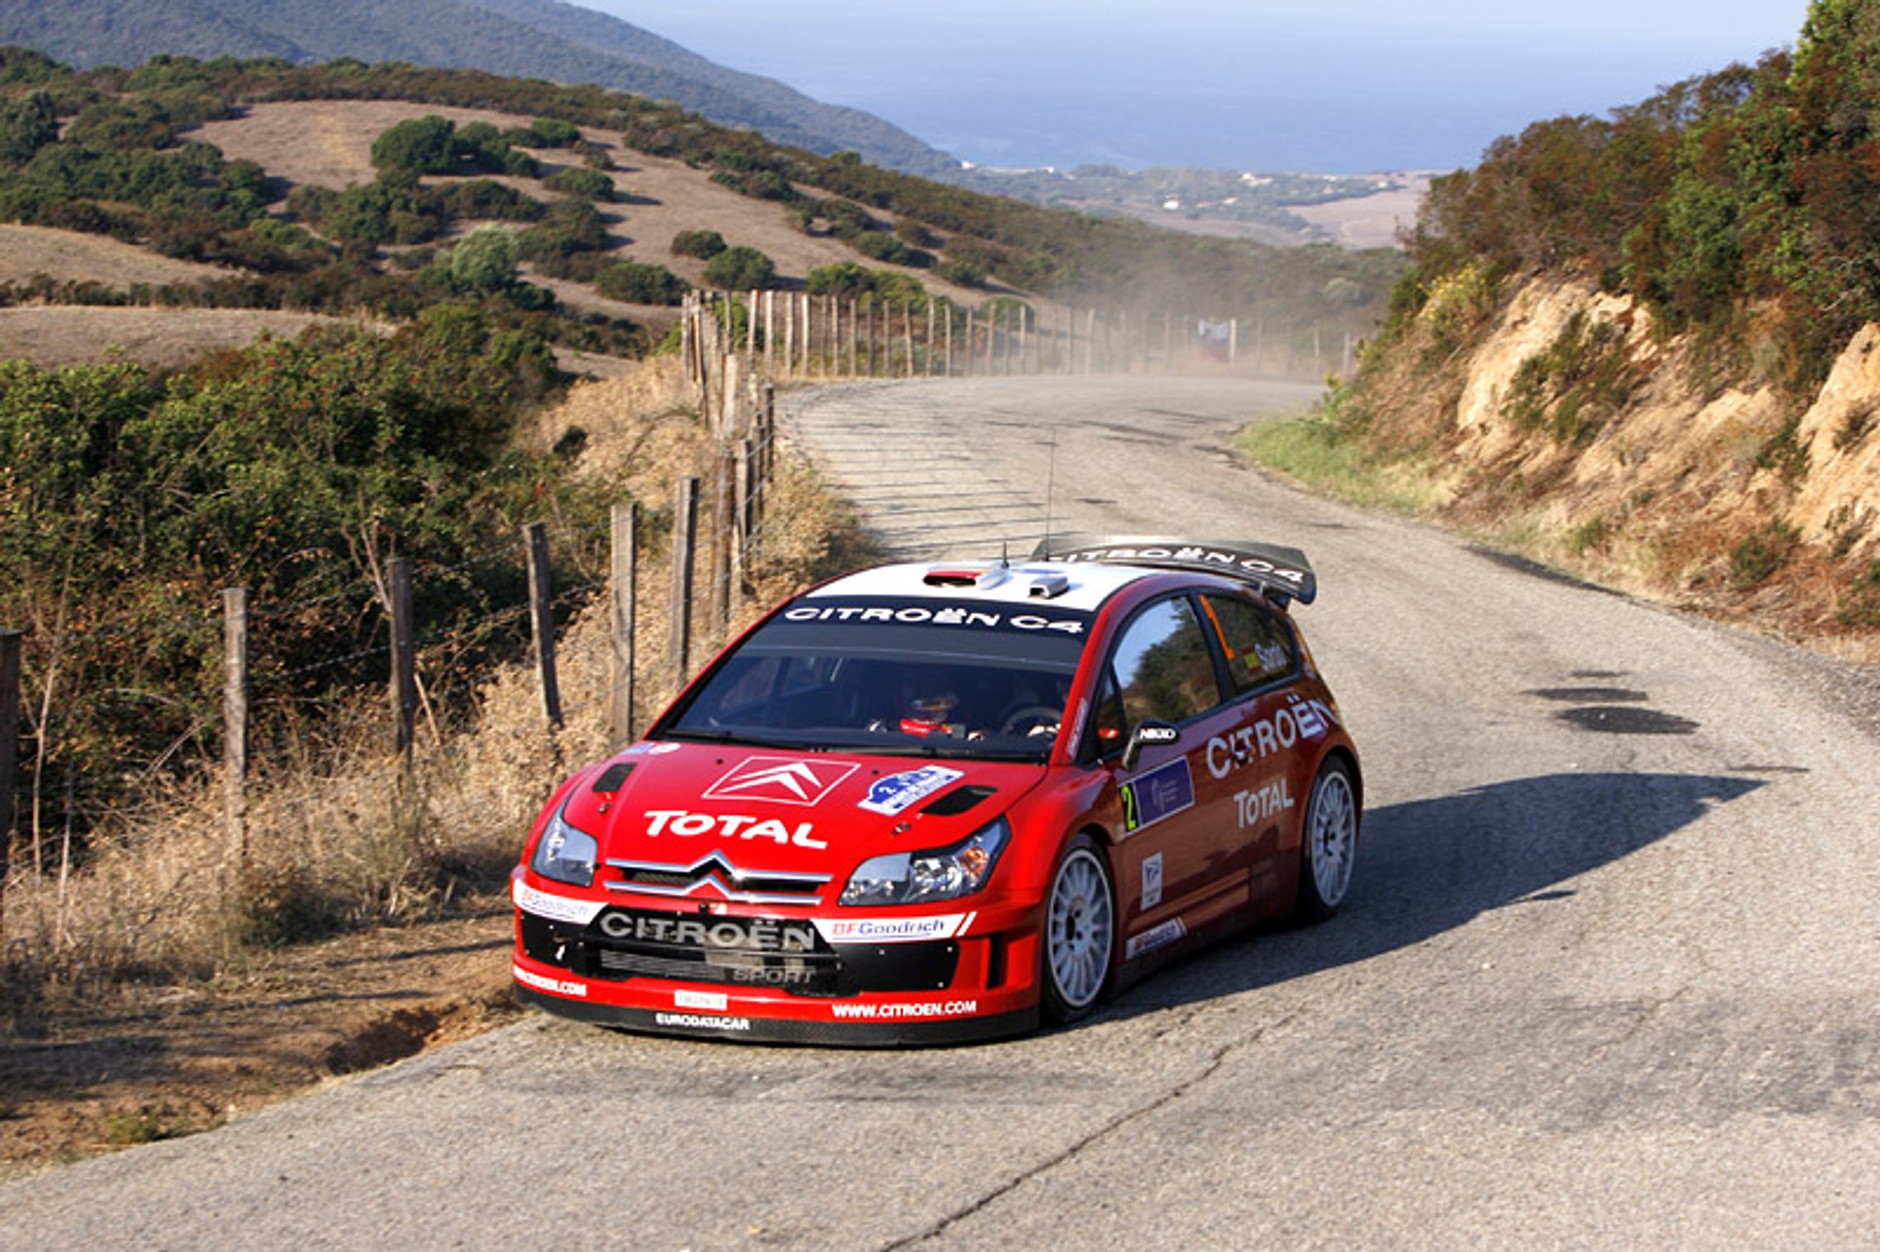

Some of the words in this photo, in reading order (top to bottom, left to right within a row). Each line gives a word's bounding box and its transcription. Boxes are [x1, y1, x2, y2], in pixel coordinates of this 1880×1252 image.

[1240, 559, 1304, 582] C4
[785, 607, 1000, 626] CITROËN
[1010, 615, 1083, 633] C4
[1120, 785, 1137, 830] 2
[1234, 778, 1294, 829] TOTAL
[643, 810, 827, 850] TOTAL
[600, 912, 814, 950] CITROËN
[732, 967, 816, 983] SPORT
[655, 1012, 750, 1031] EURODATACAR
[831, 1000, 977, 1019] WWW.CITROEN.COM
